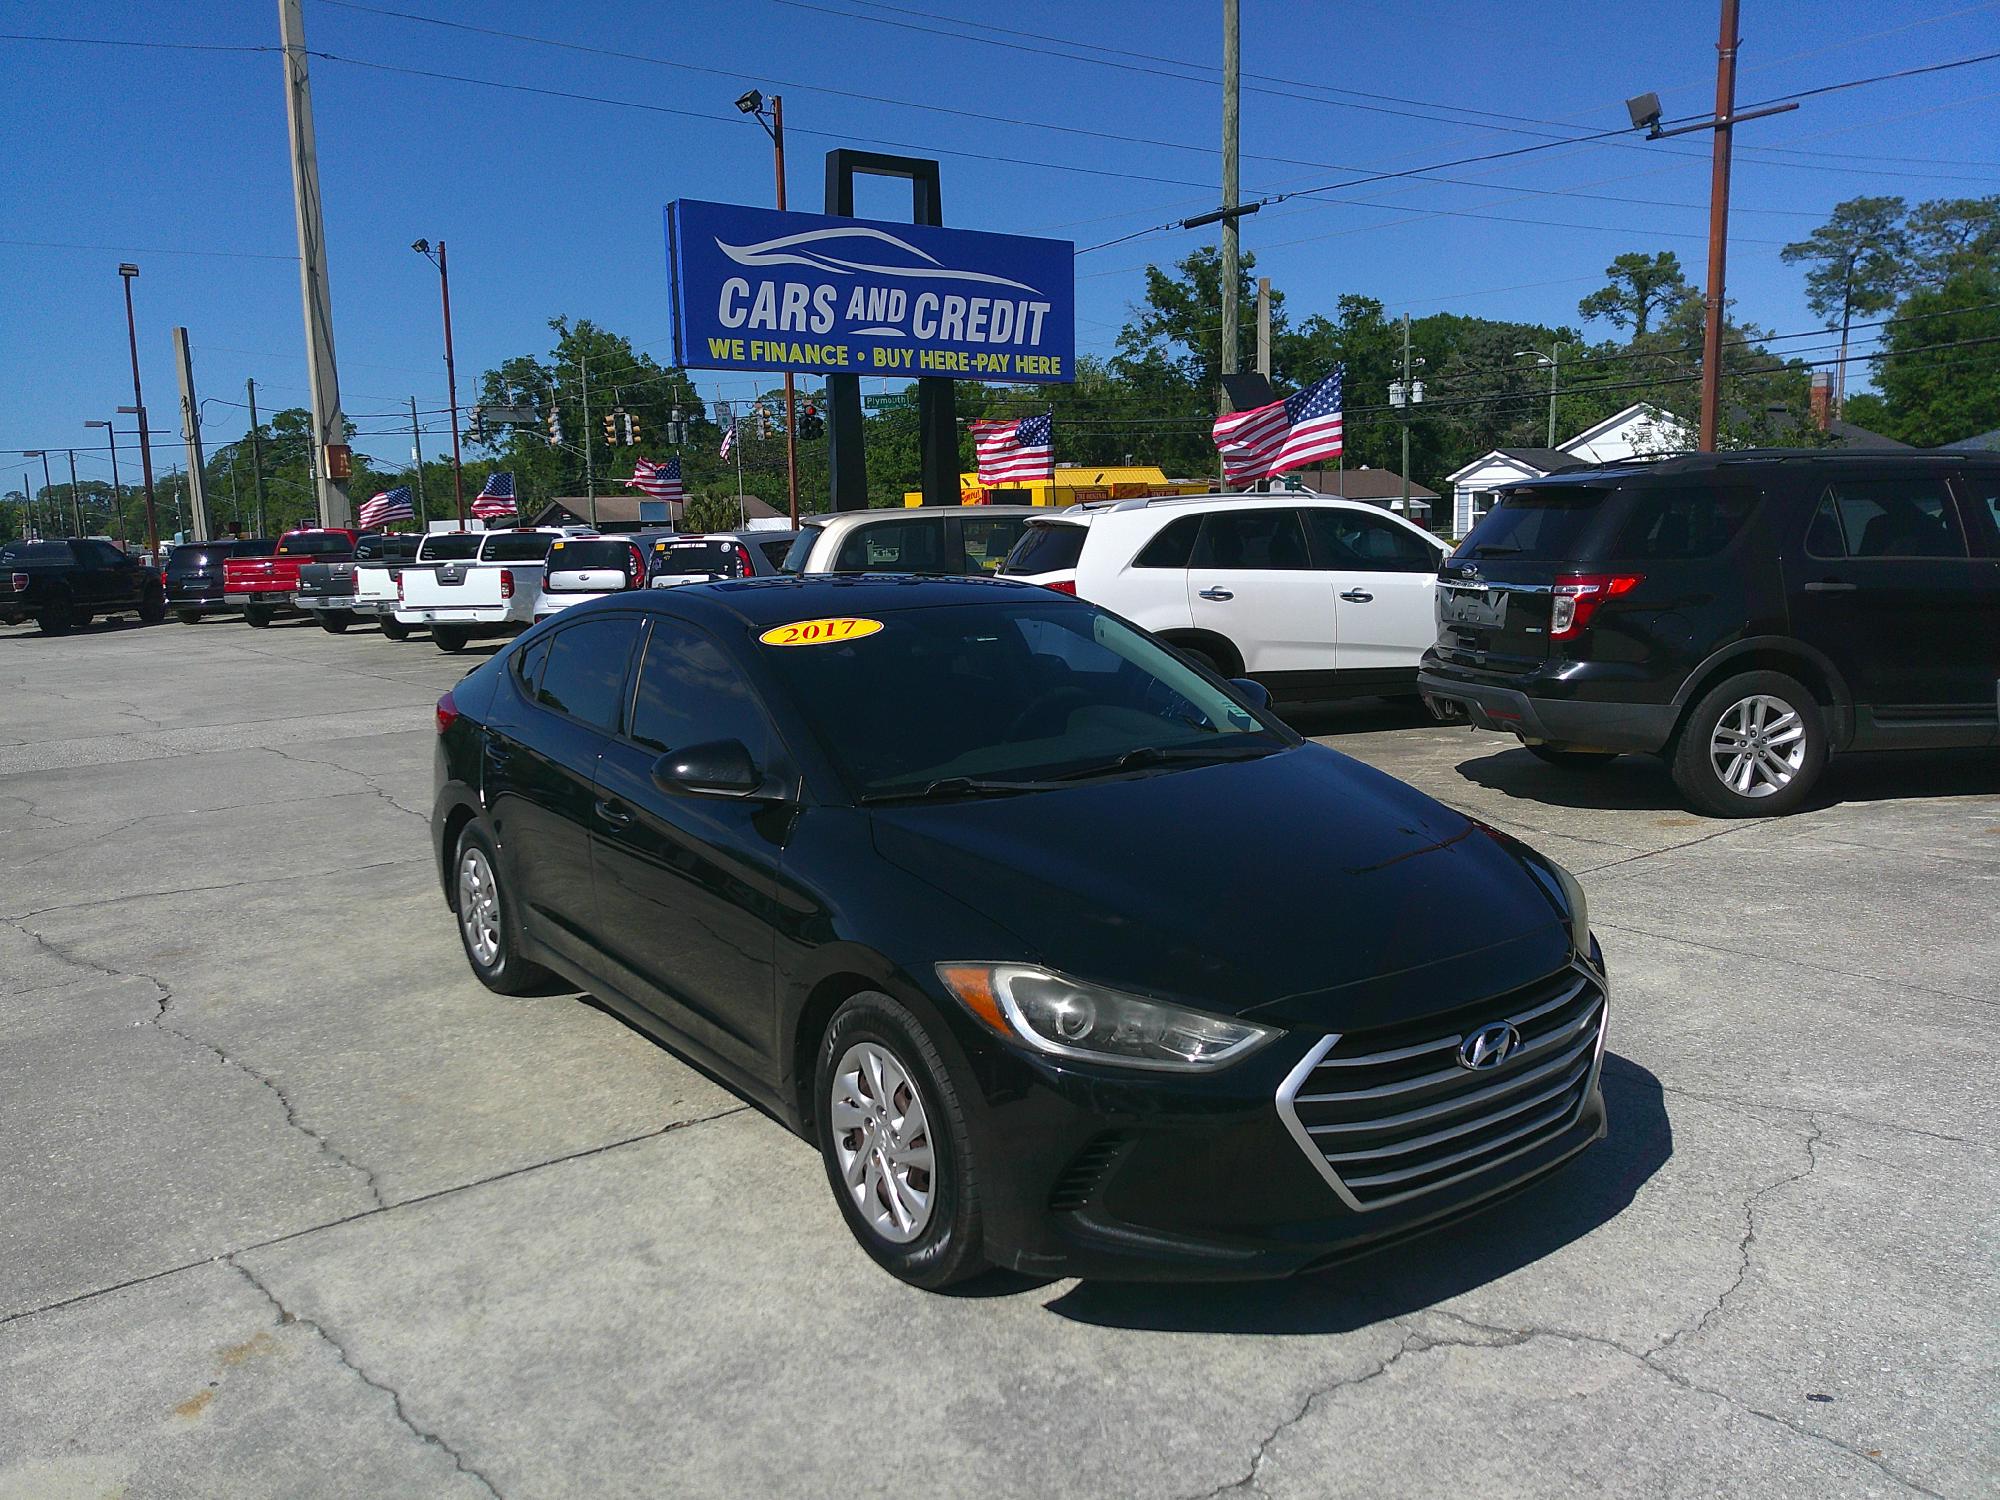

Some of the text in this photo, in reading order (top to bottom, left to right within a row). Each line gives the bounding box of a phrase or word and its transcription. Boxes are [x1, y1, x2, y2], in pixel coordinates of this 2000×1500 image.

[718, 277, 1051, 346] CARS AND CREDIT
[707, 337, 745, 361] WE
[750, 340, 849, 366] FINANCE
[873, 347, 914, 369] BUY
[1015, 354, 1062, 375] HERE
[866, 396, 906, 405] Plymouth
[783, 620, 857, 643] 2017
